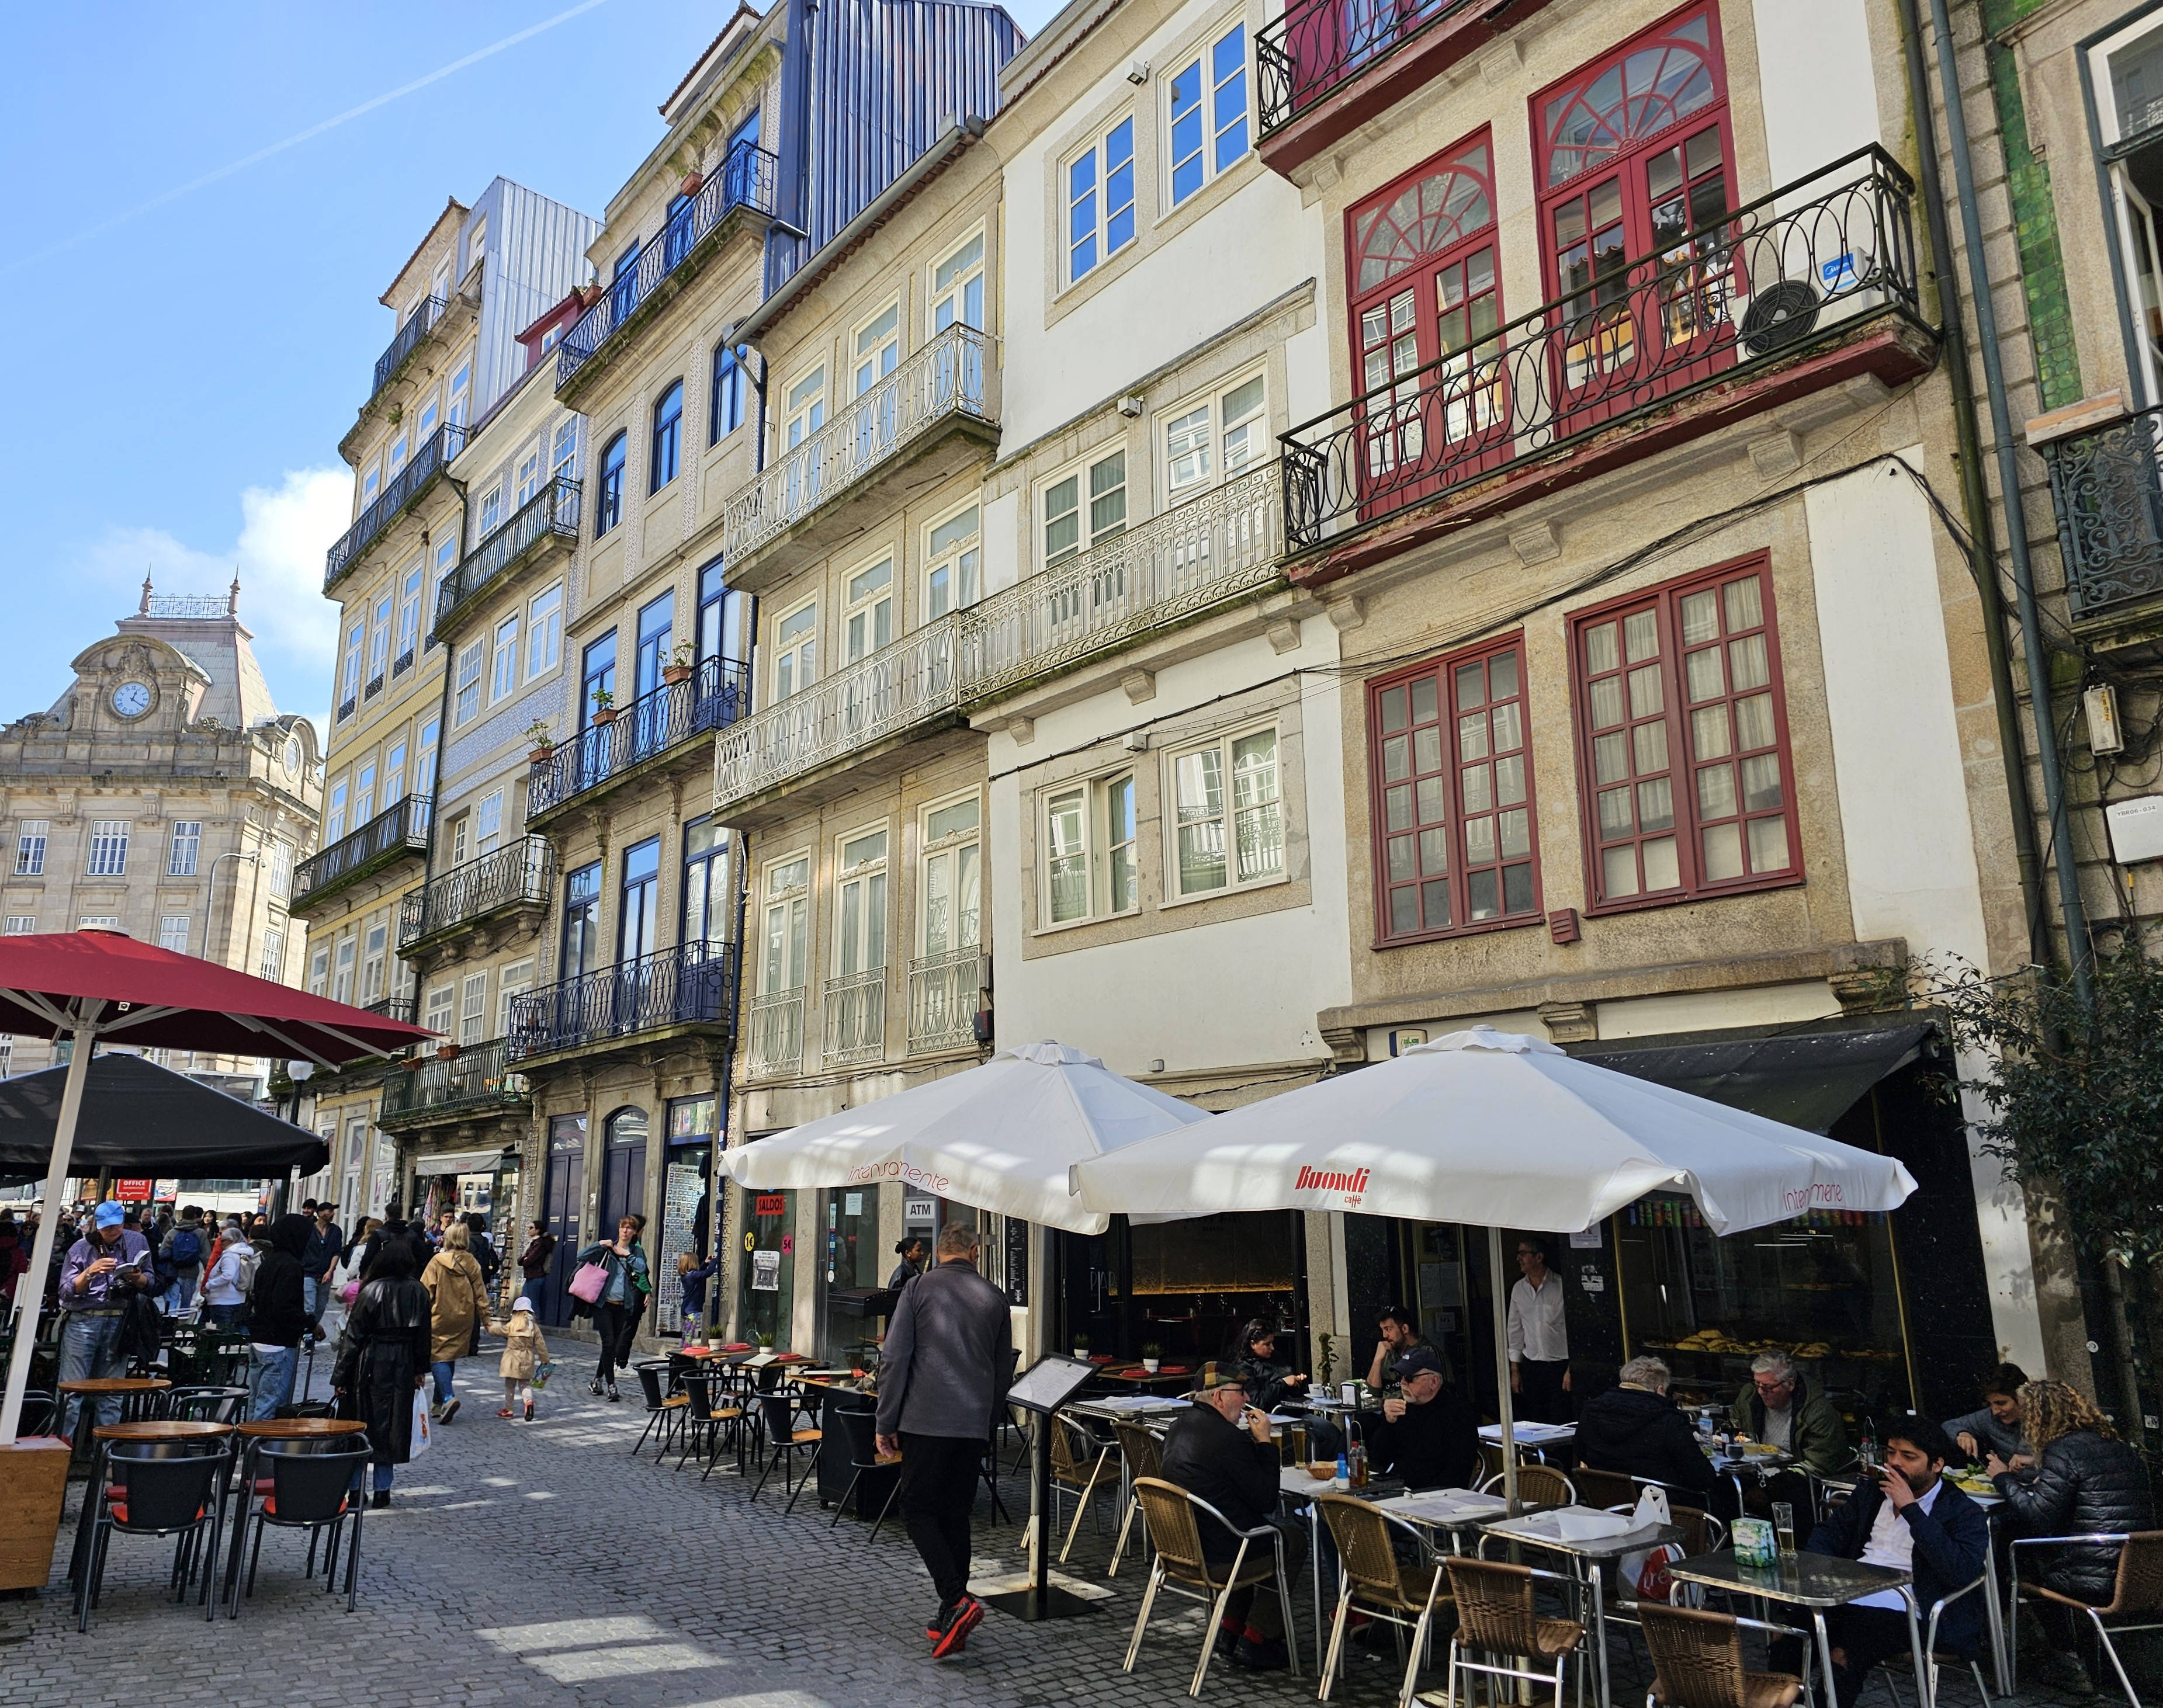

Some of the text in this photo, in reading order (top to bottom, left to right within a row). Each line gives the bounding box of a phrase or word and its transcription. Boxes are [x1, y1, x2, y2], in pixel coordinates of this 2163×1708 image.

[2117, 806, 2156, 817] YBR06-034
[1295, 1165, 1370, 1193] Buondi
[759, 1198, 782, 1211] SALDOS
[1344, 1195, 1362, 1208] caffè
[910, 1204, 930, 1215] ATM
[746, 1236, 753, 1247] 1€
[783, 1239, 792, 1249] 5€
